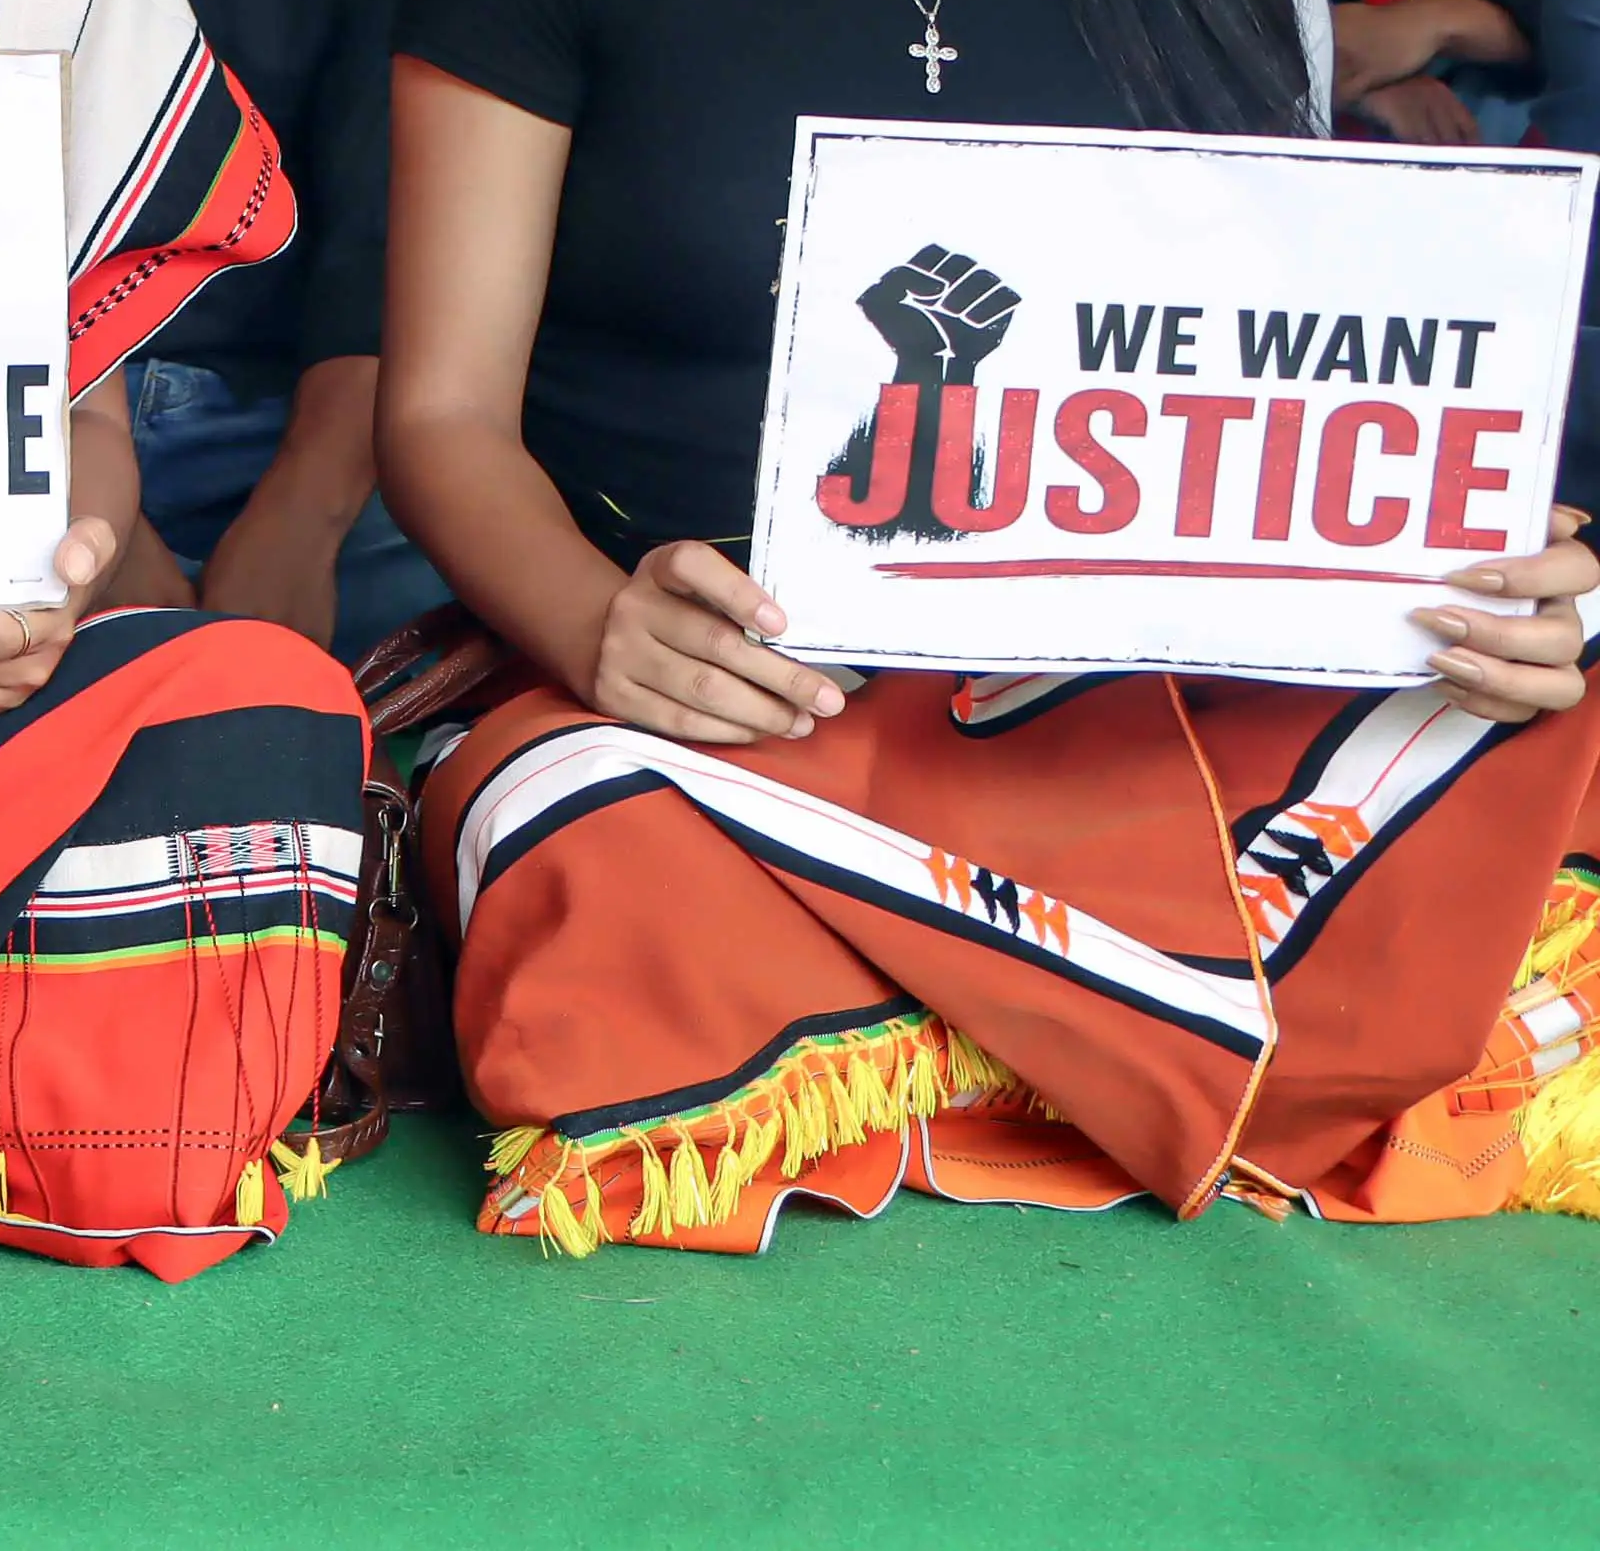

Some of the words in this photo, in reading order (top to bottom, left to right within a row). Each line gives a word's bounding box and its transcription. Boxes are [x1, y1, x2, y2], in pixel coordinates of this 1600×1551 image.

[1076, 303, 1203, 376] WE
[1238, 310, 1496, 389] WANT
[816, 383, 1523, 553] JUSTICE
